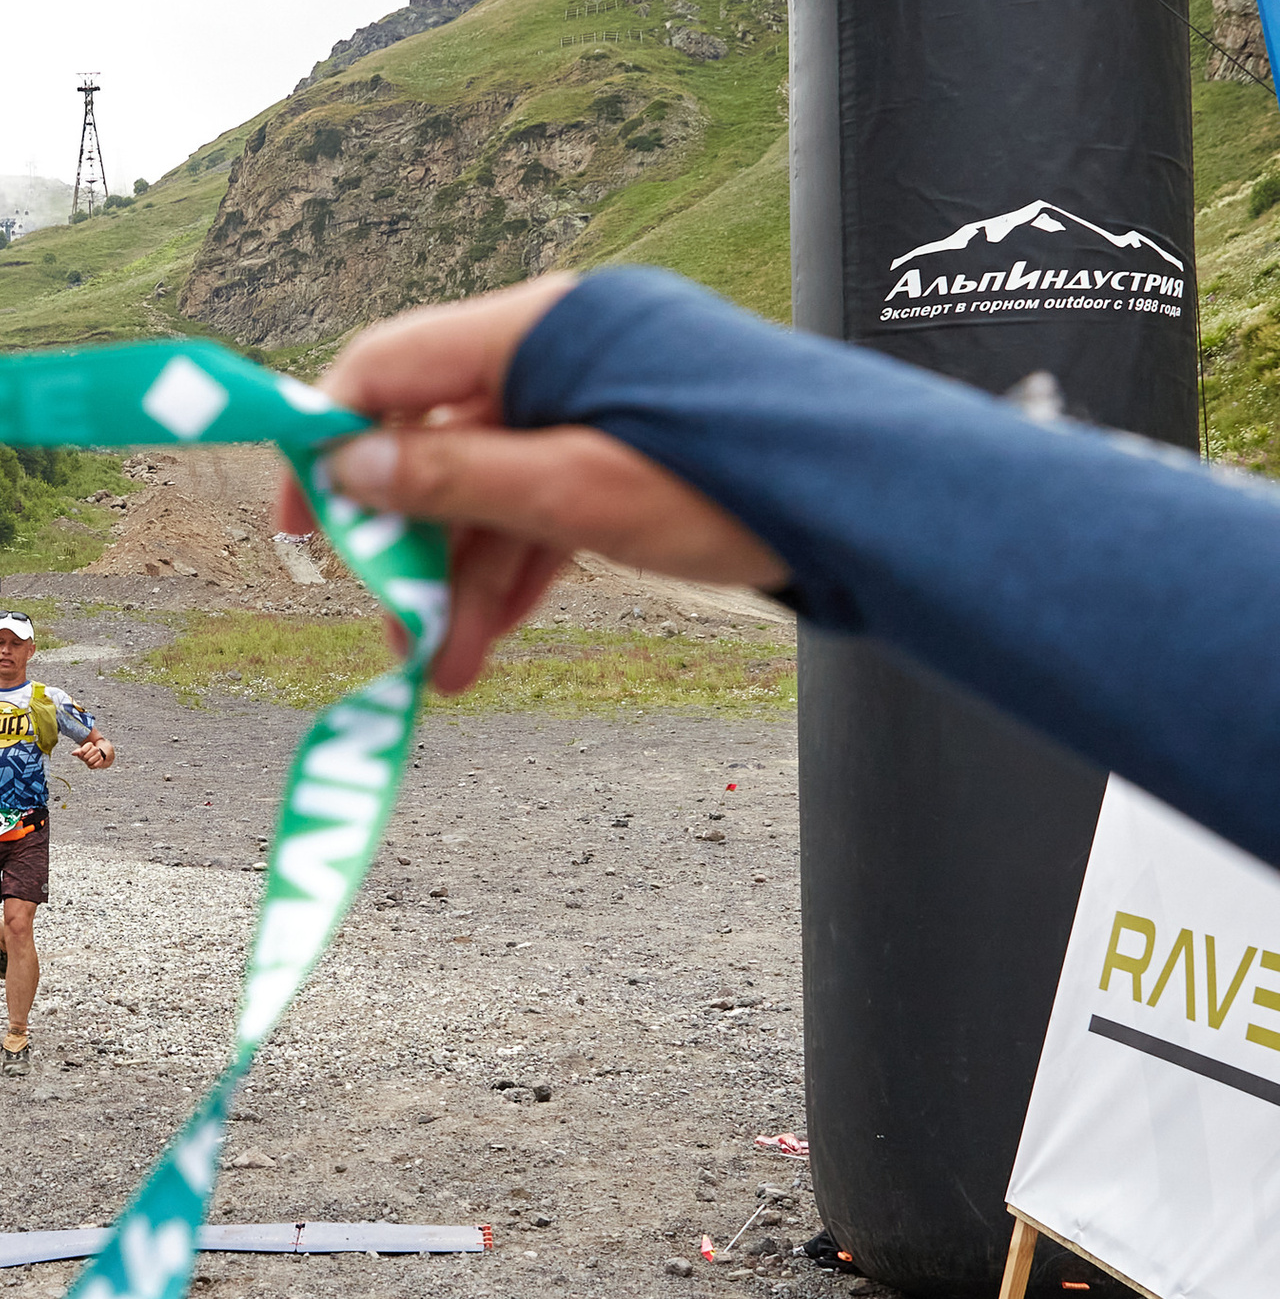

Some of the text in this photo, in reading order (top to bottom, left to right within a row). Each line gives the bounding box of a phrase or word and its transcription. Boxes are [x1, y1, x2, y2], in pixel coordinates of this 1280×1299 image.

[879, 295, 1182, 322] Эксперт в горном outdoor с 1988 года
